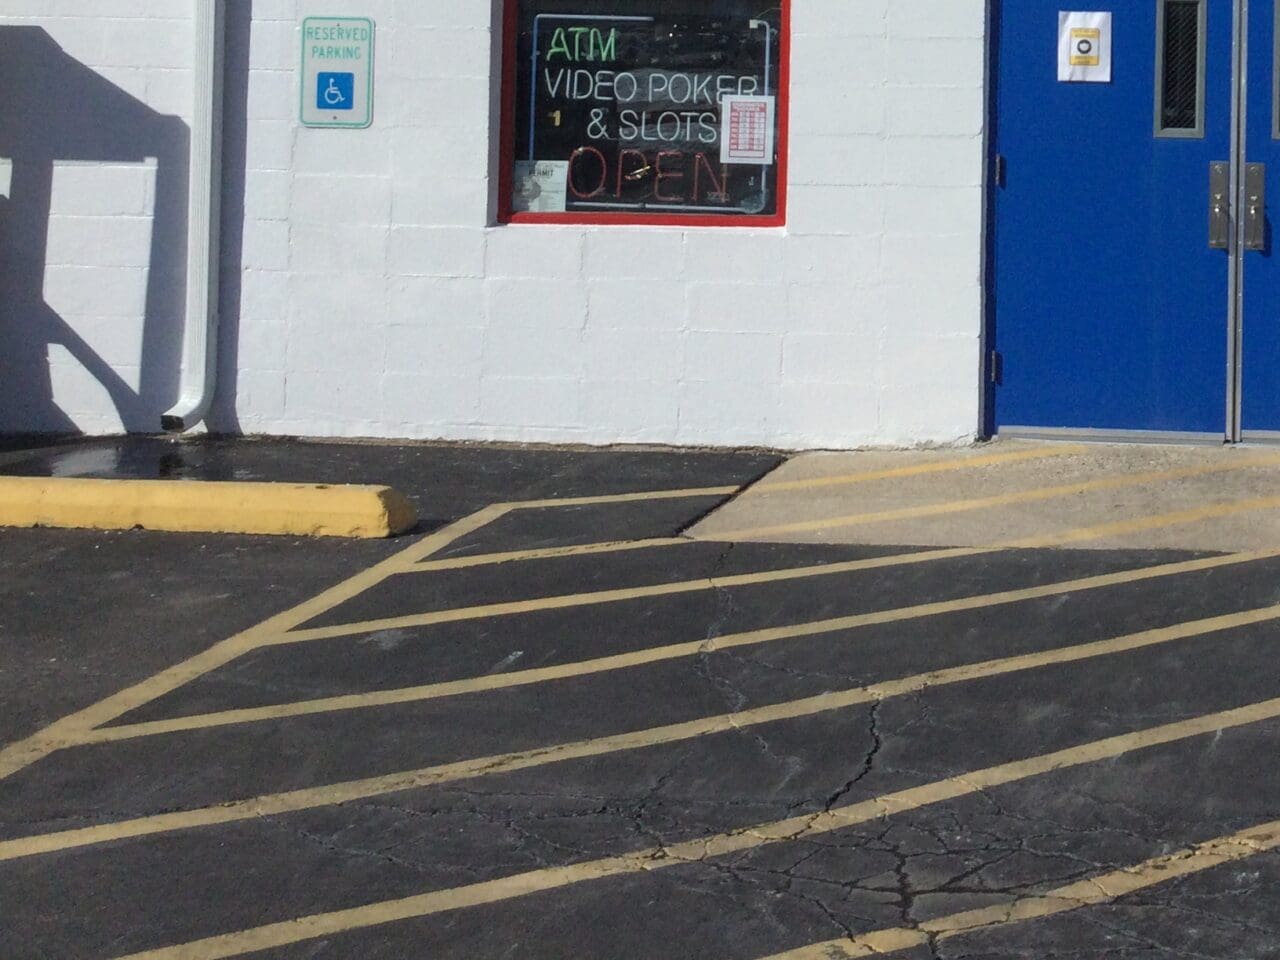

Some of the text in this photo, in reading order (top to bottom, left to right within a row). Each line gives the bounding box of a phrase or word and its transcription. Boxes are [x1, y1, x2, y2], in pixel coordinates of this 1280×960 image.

[306, 26, 368, 41] RESERVED
[546, 27, 618, 62] ATM
[312, 46, 361, 59] PARKING
[544, 68, 638, 102] VIDEO
[587, 109, 608, 140] &
[619, 110, 717, 143] SLOTS
[568, 146, 729, 204] OPEN
